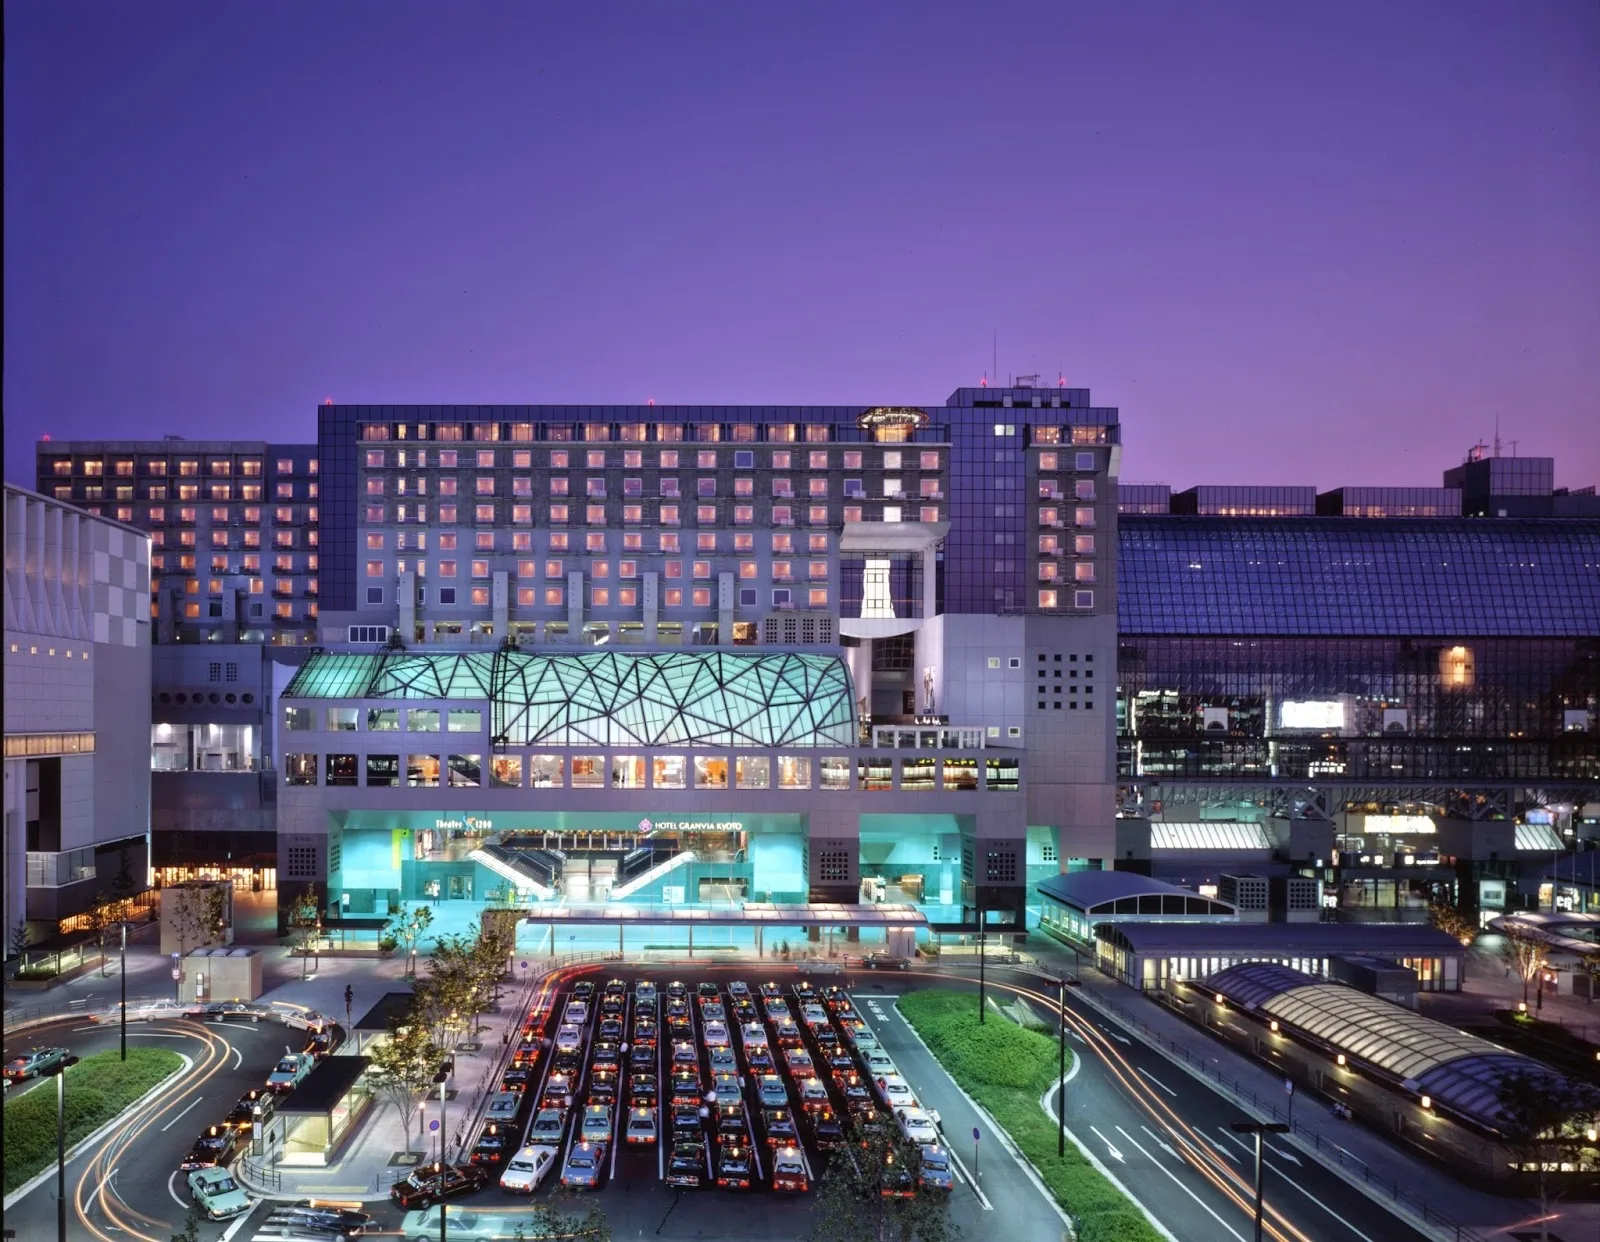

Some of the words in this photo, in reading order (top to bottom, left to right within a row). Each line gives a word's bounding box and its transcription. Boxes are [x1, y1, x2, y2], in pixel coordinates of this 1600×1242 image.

[435, 819, 462, 829] Theater
[679, 822, 715, 830] GRANVIA
[717, 822, 742, 830] KYOTO
